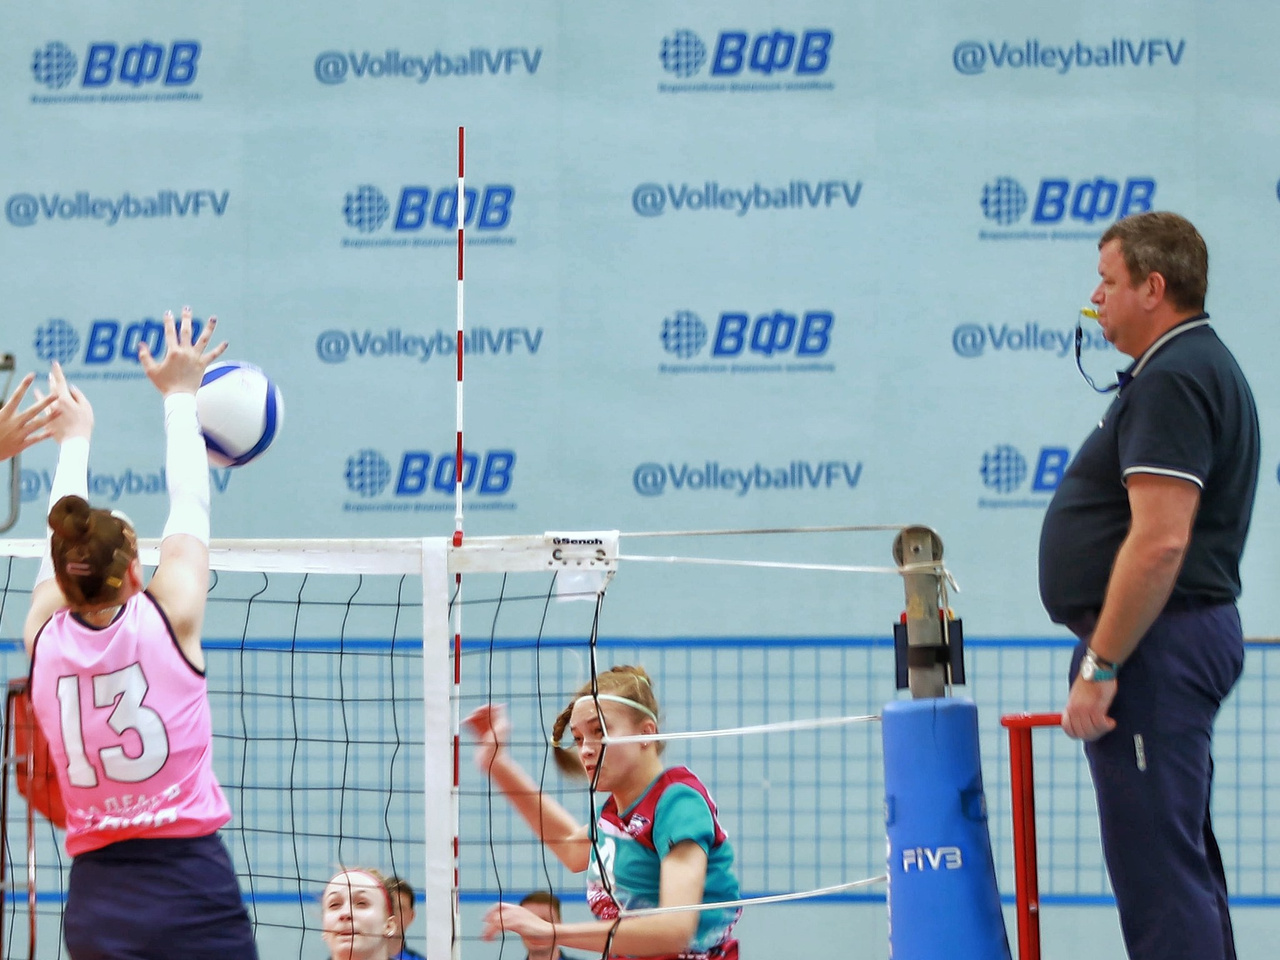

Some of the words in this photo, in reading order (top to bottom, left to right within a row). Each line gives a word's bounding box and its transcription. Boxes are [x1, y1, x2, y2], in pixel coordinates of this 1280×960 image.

[82, 40, 201, 88] ВФВ
[315, 49, 541, 84] @VolleyballVFV
[712, 29, 834, 76] ВФВ
[954, 39, 1185, 74] @VolleyballVFV
[6, 192, 228, 226] @VolleyballVFV
[393, 184, 515, 231] ВФВ
[633, 181, 862, 216] @VolleyballVFV
[712, 310, 834, 358] ВФВ
[395, 449, 517, 496] ВФВ
[634, 462, 862, 496] @VolleyballVFV
[56, 661, 170, 788] 13
